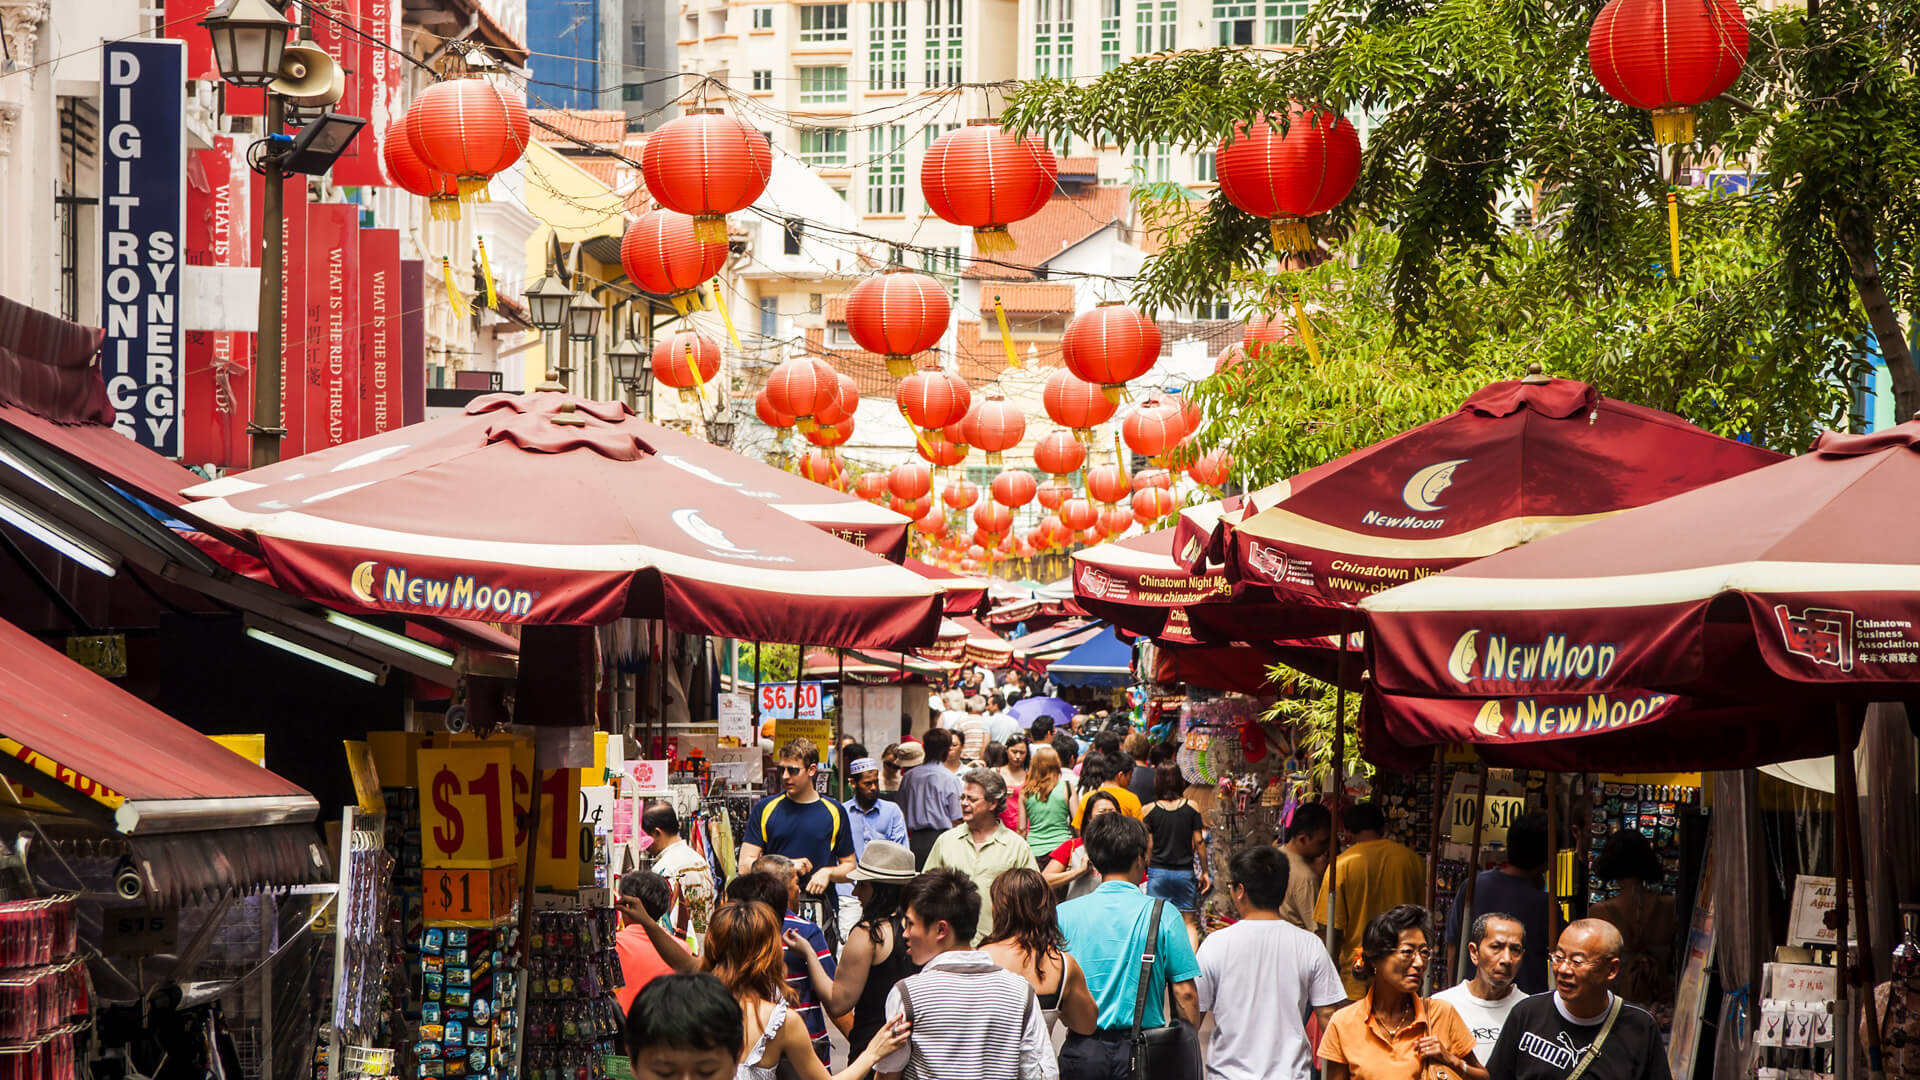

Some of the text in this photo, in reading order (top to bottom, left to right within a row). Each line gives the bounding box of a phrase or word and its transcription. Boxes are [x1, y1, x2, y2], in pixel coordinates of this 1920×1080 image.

[215, 184, 230, 256] WHAT IS
[106, 51, 142, 441] DIGITRONICS
[373, 270, 386, 312] WHAT
[145, 231, 176, 447] SYNERGY
[373, 315, 386, 329] IS
[329, 248, 343, 444] WHAT IS THE RED THREAD?
[373, 332, 387, 359] THE
[374, 362, 387, 388] RED
[1361, 509, 1447, 530] NewMoon
[1139, 574, 1187, 588] Chinatown
[1188, 575, 1212, 591] Night
[1330, 559, 1409, 580] Chinatown
[383, 566, 532, 616] NewMoon
[1855, 619, 1912, 629] Chinatown
[1856, 630, 1904, 639] Business
[1483, 633, 1617, 682] NewMoon
[1857, 639, 1920, 649] Association
[431, 763, 504, 860] $1
[1453, 798, 1475, 827] 10
[439, 872, 473, 913] $1
[1518, 1031, 1572, 1070] PUMA
